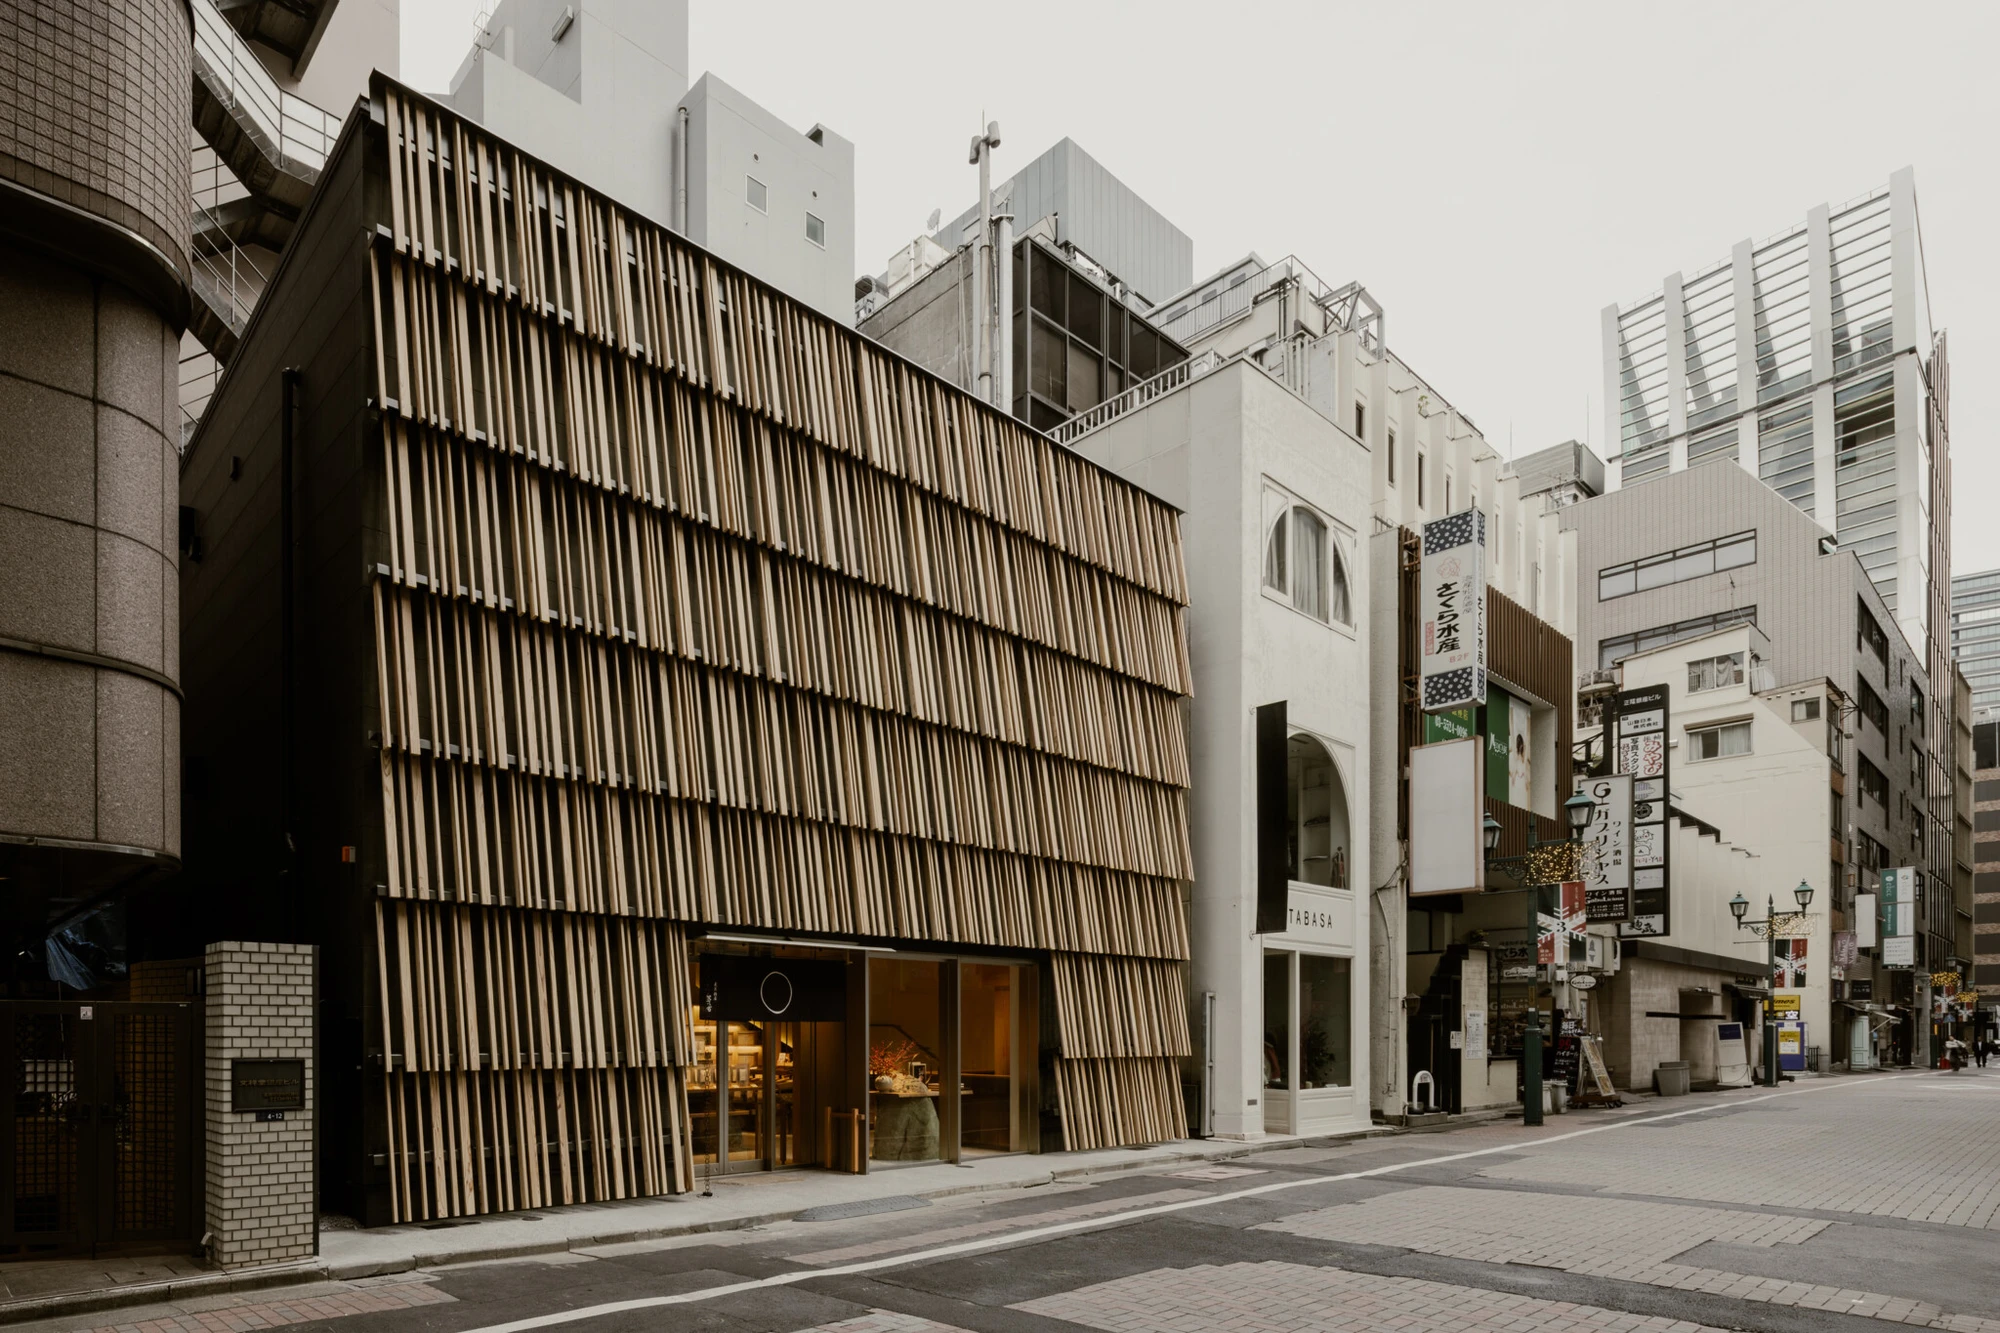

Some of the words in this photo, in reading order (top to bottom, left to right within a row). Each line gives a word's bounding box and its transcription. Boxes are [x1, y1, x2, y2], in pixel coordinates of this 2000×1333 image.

[1435, 581, 1461, 655] さくら水産
[1449, 652, 1469, 663] B2F
[1643, 740, 1662, 776] みやび
[1595, 809, 1609, 886] ガブリシャス
[1612, 821, 1622, 866] ワイン酒場
[1289, 909, 1332, 929] TABASA
[1556, 922, 1566, 932] 3
